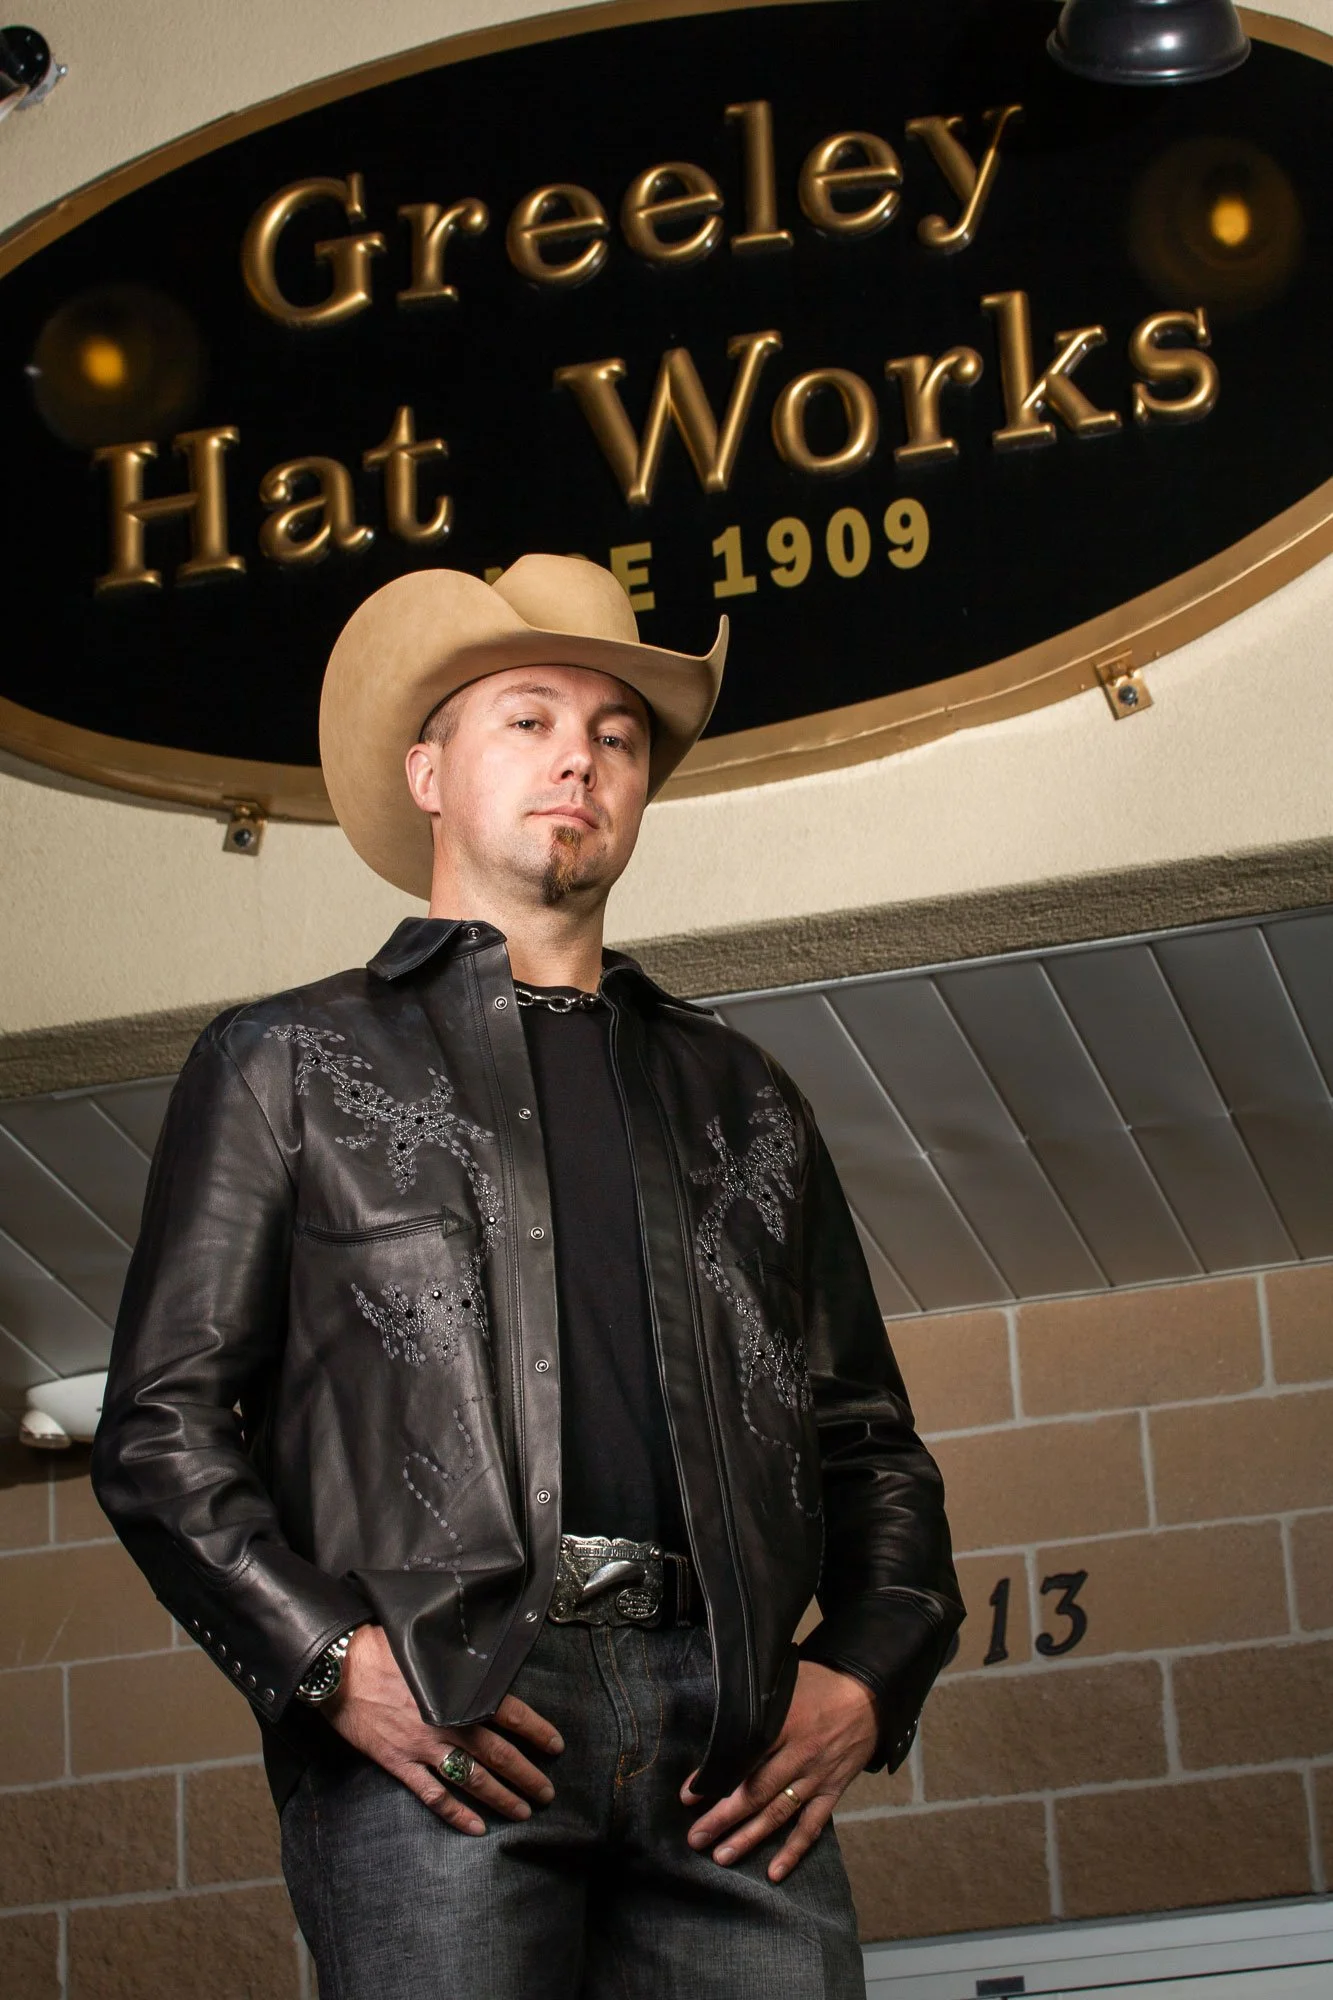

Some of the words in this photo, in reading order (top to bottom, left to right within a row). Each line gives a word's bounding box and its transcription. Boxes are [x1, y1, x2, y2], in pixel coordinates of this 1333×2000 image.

[241, 99, 1023, 329] Greeley
[94, 405, 453, 595] Hat
[553, 290, 1221, 506] Works
[711, 497, 931, 599] 1909
[946, 1569, 1088, 1666] 13
